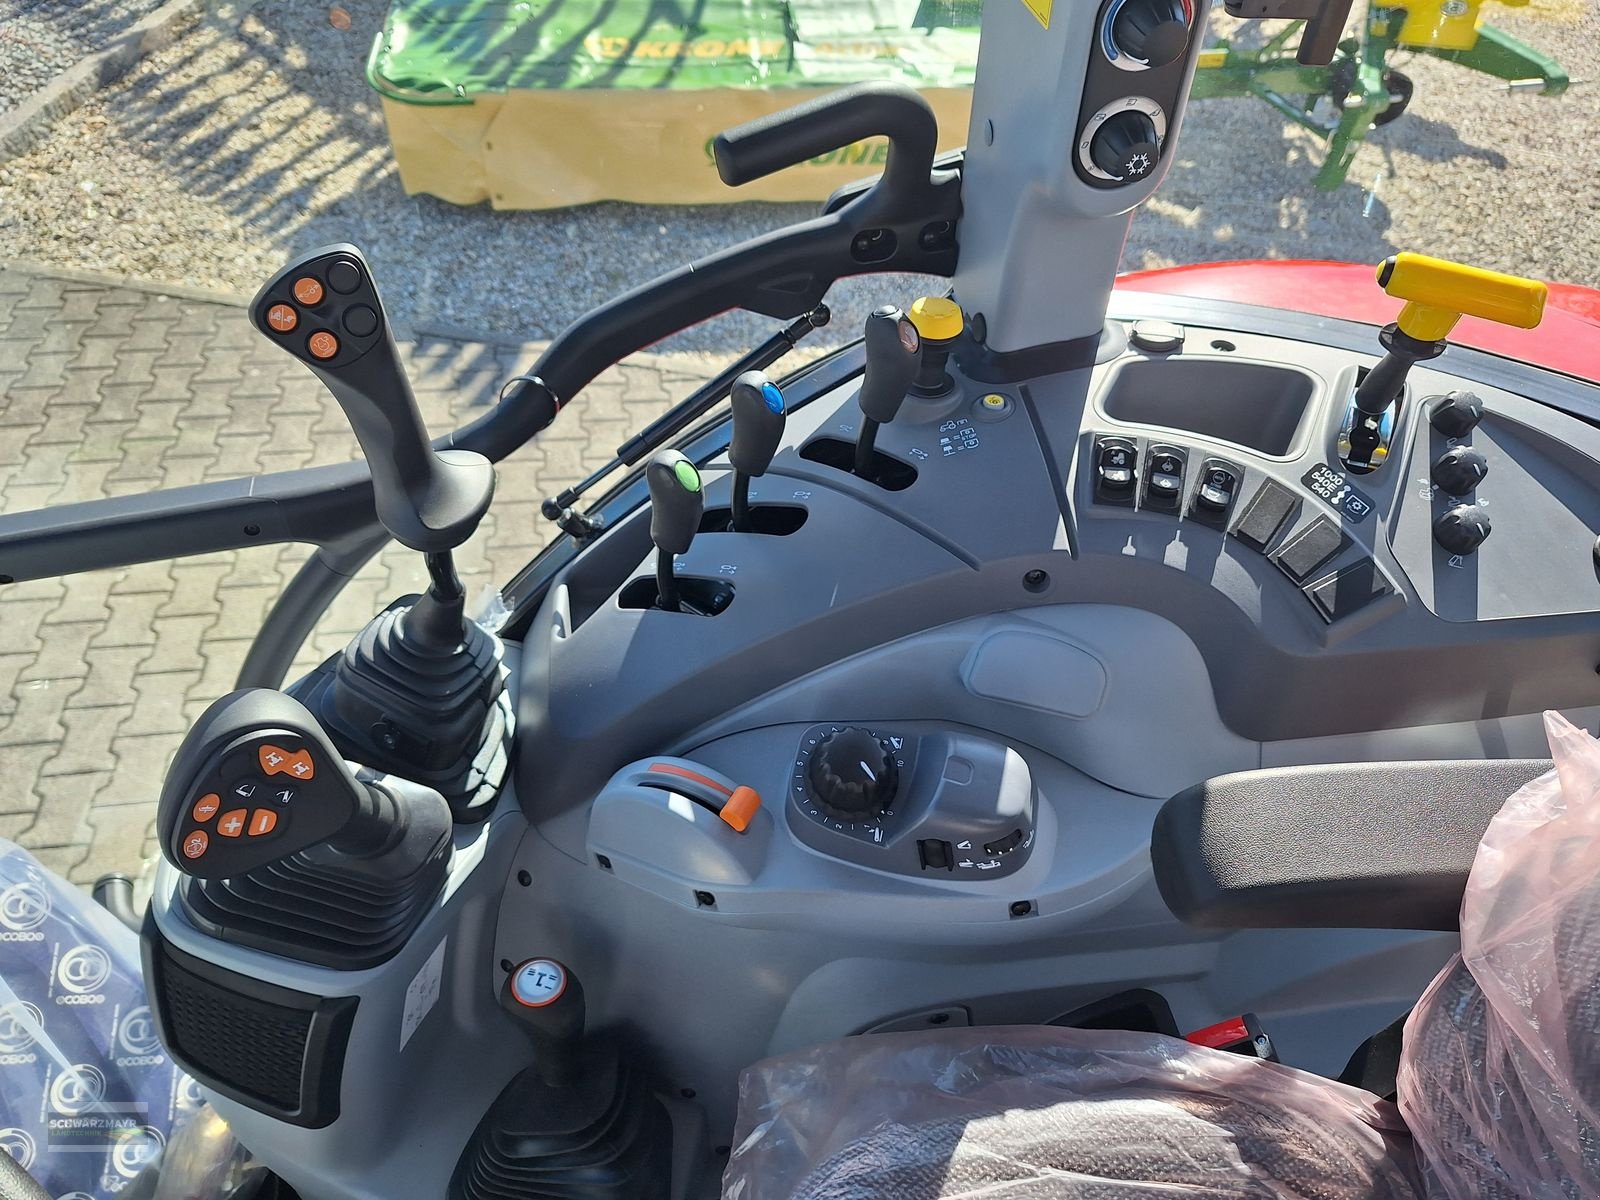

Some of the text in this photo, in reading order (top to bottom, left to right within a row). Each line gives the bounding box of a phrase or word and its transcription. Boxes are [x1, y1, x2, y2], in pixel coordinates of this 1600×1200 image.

[1311, 471, 1337, 492] 540E
[1320, 467, 1343, 486] 1000
[1311, 482, 1330, 498] 540
